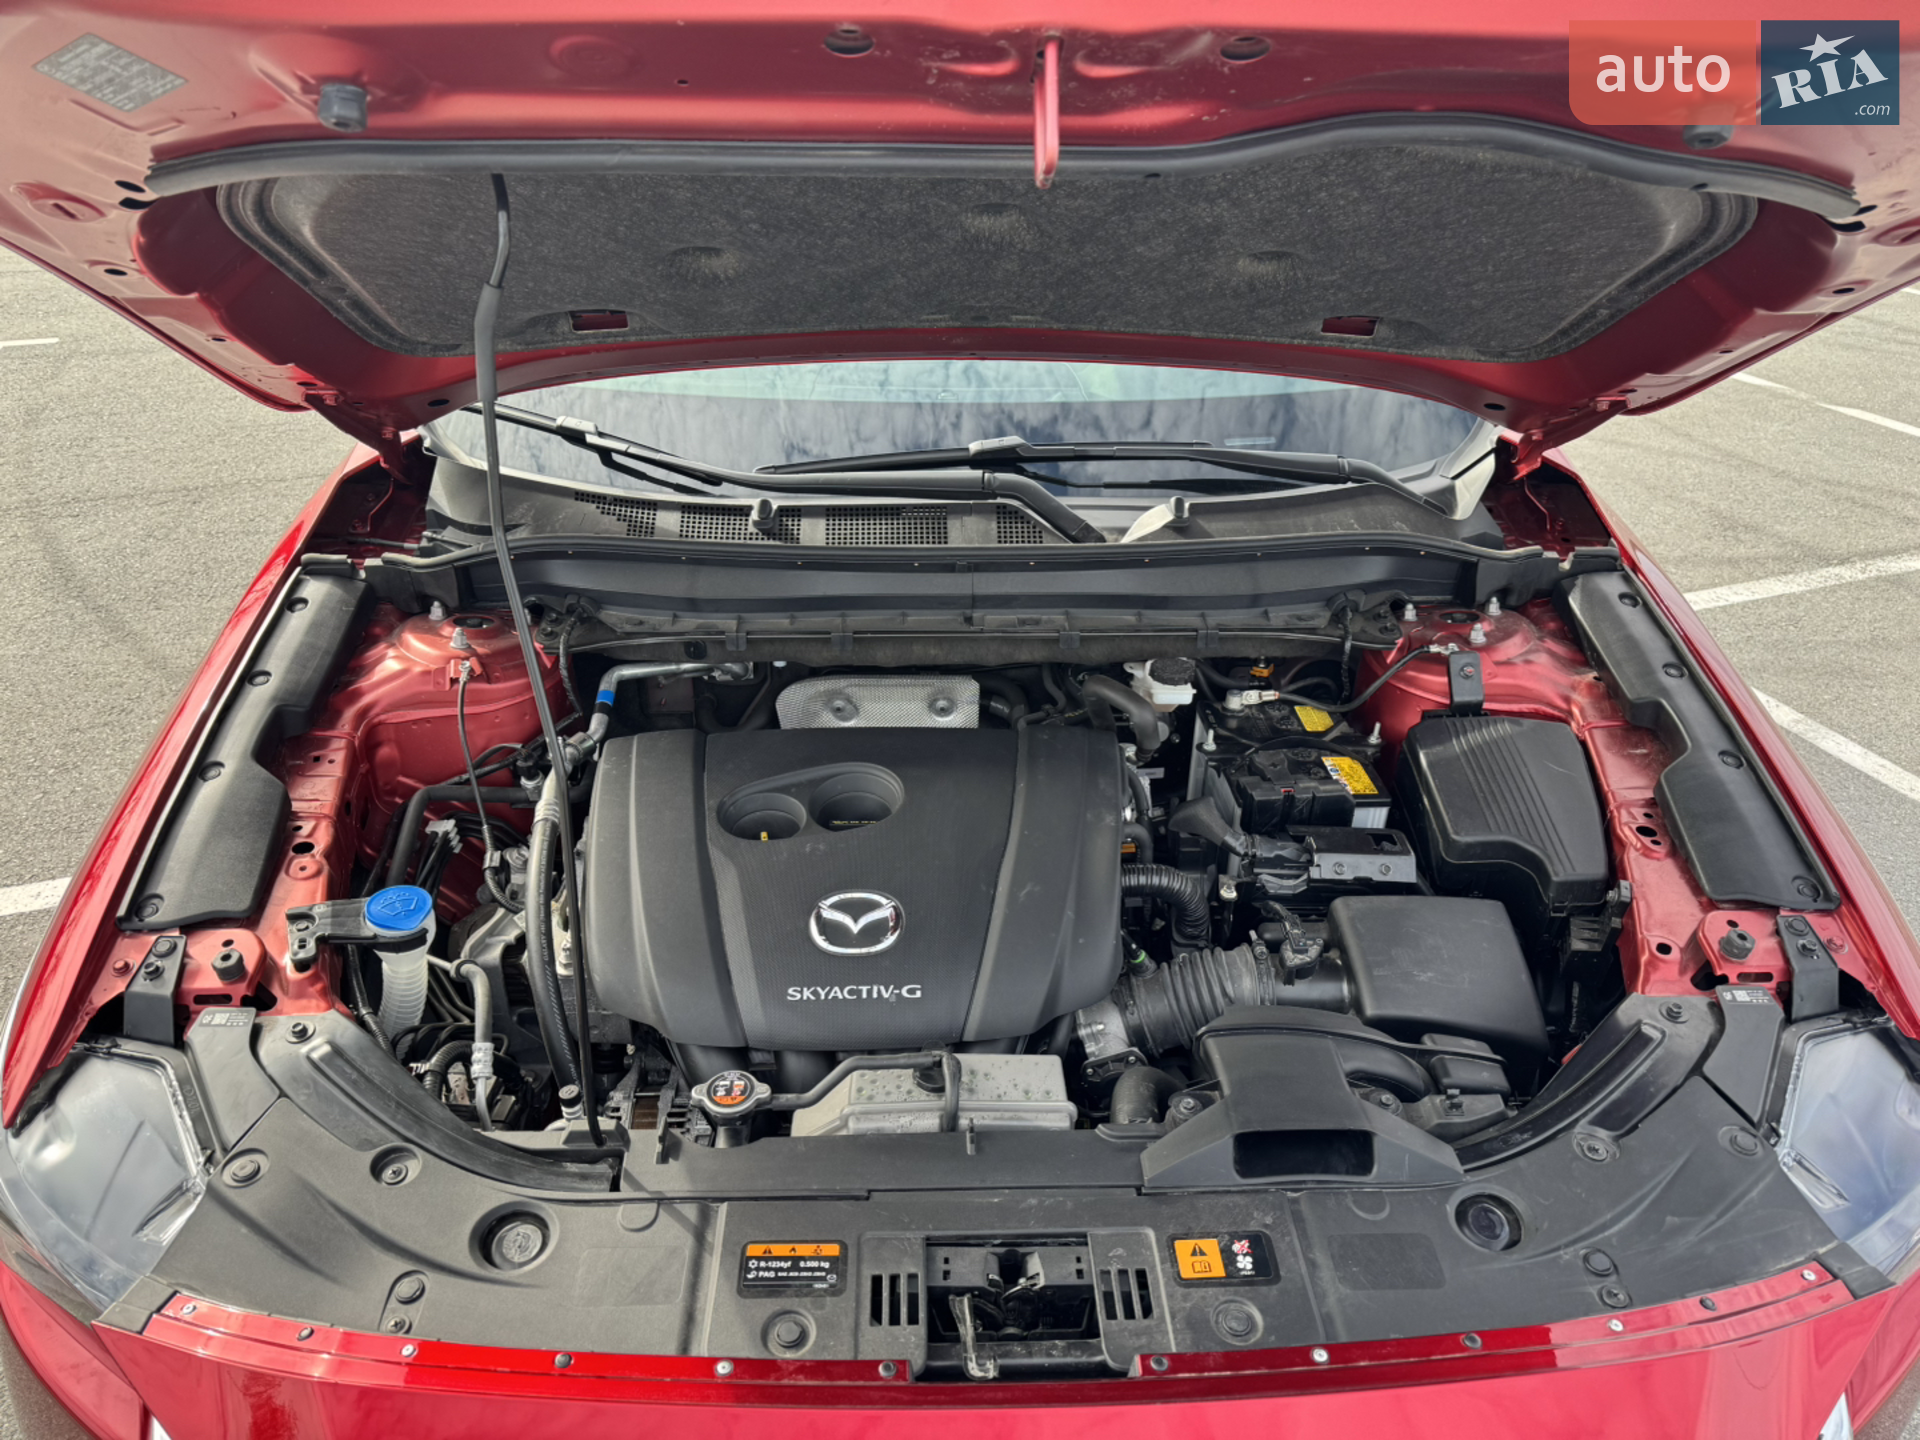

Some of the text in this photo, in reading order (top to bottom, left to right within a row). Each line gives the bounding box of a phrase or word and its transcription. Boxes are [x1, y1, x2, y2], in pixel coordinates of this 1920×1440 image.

[786, 984, 922, 1000] SKYACTIV-G
[759, 1260, 830, 1269] R-1234yf 0.500 kg
